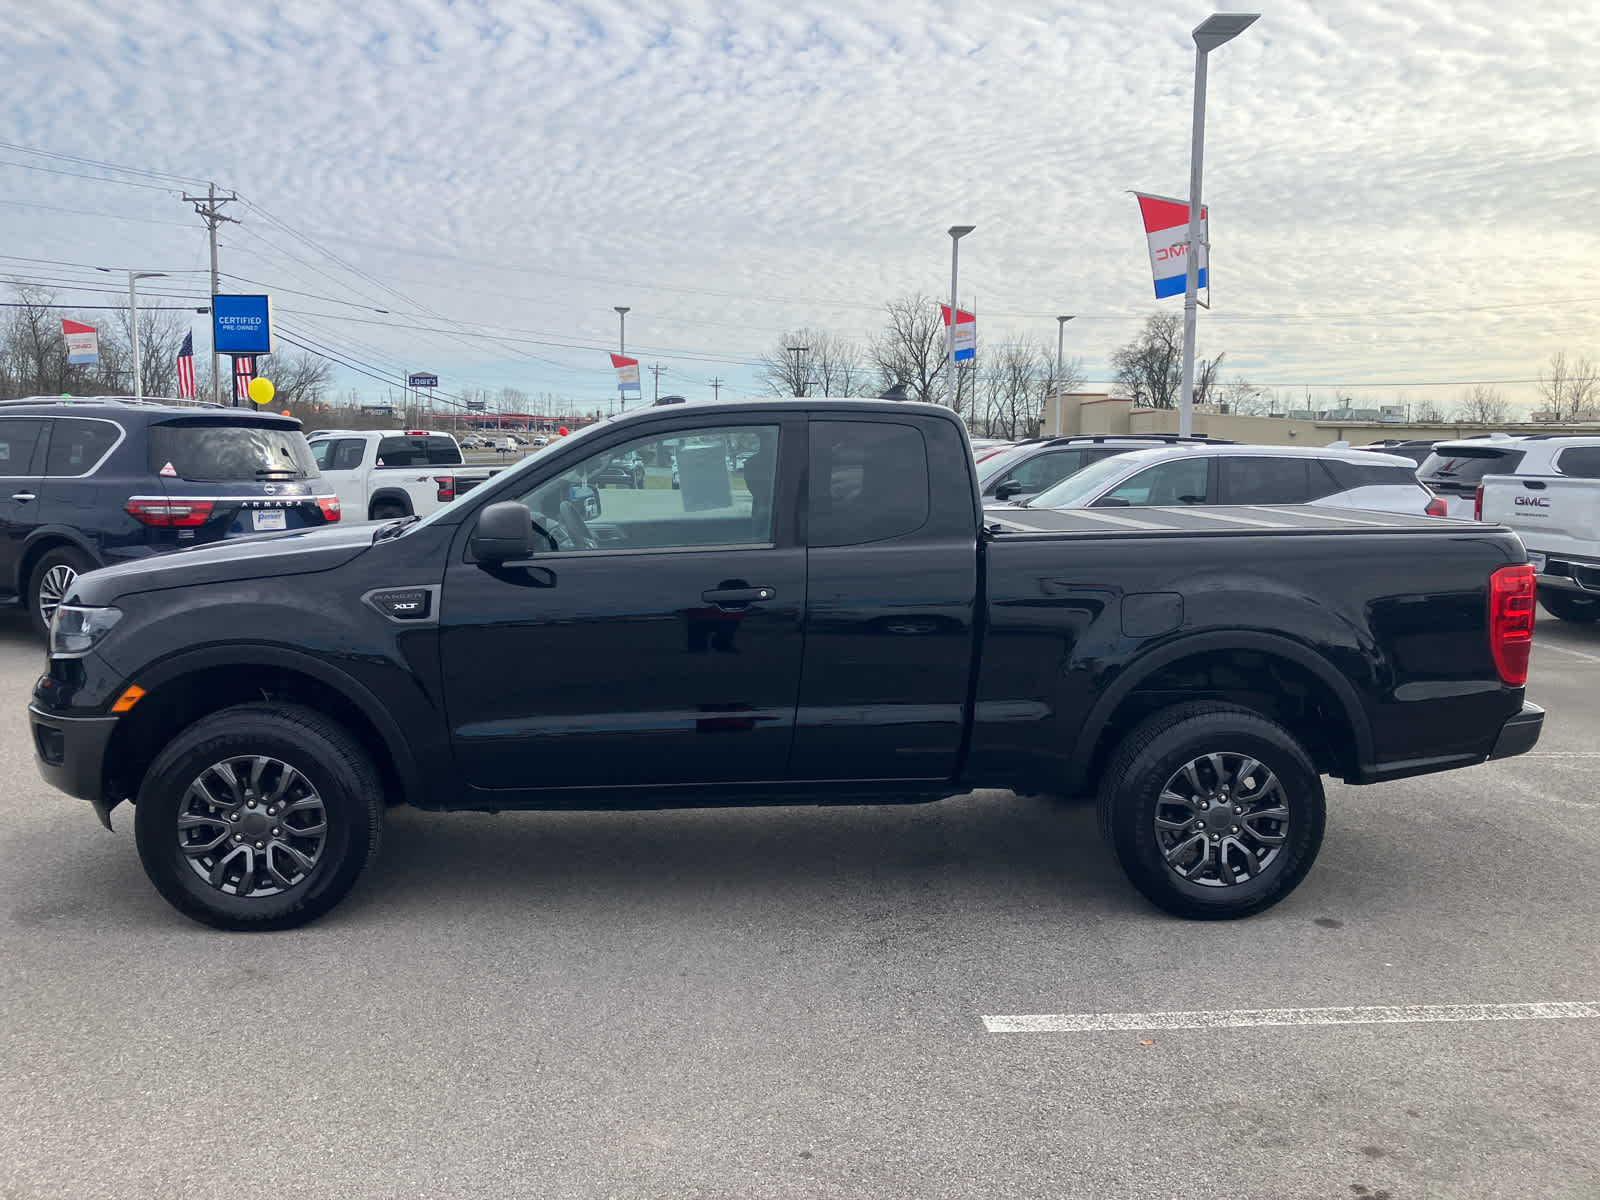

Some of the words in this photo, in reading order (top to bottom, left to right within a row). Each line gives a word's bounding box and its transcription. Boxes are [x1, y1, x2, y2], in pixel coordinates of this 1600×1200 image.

[218, 316, 262, 325] CERTIFIED
[1514, 496, 1552, 507] GMC
[393, 602, 419, 610] XLT
